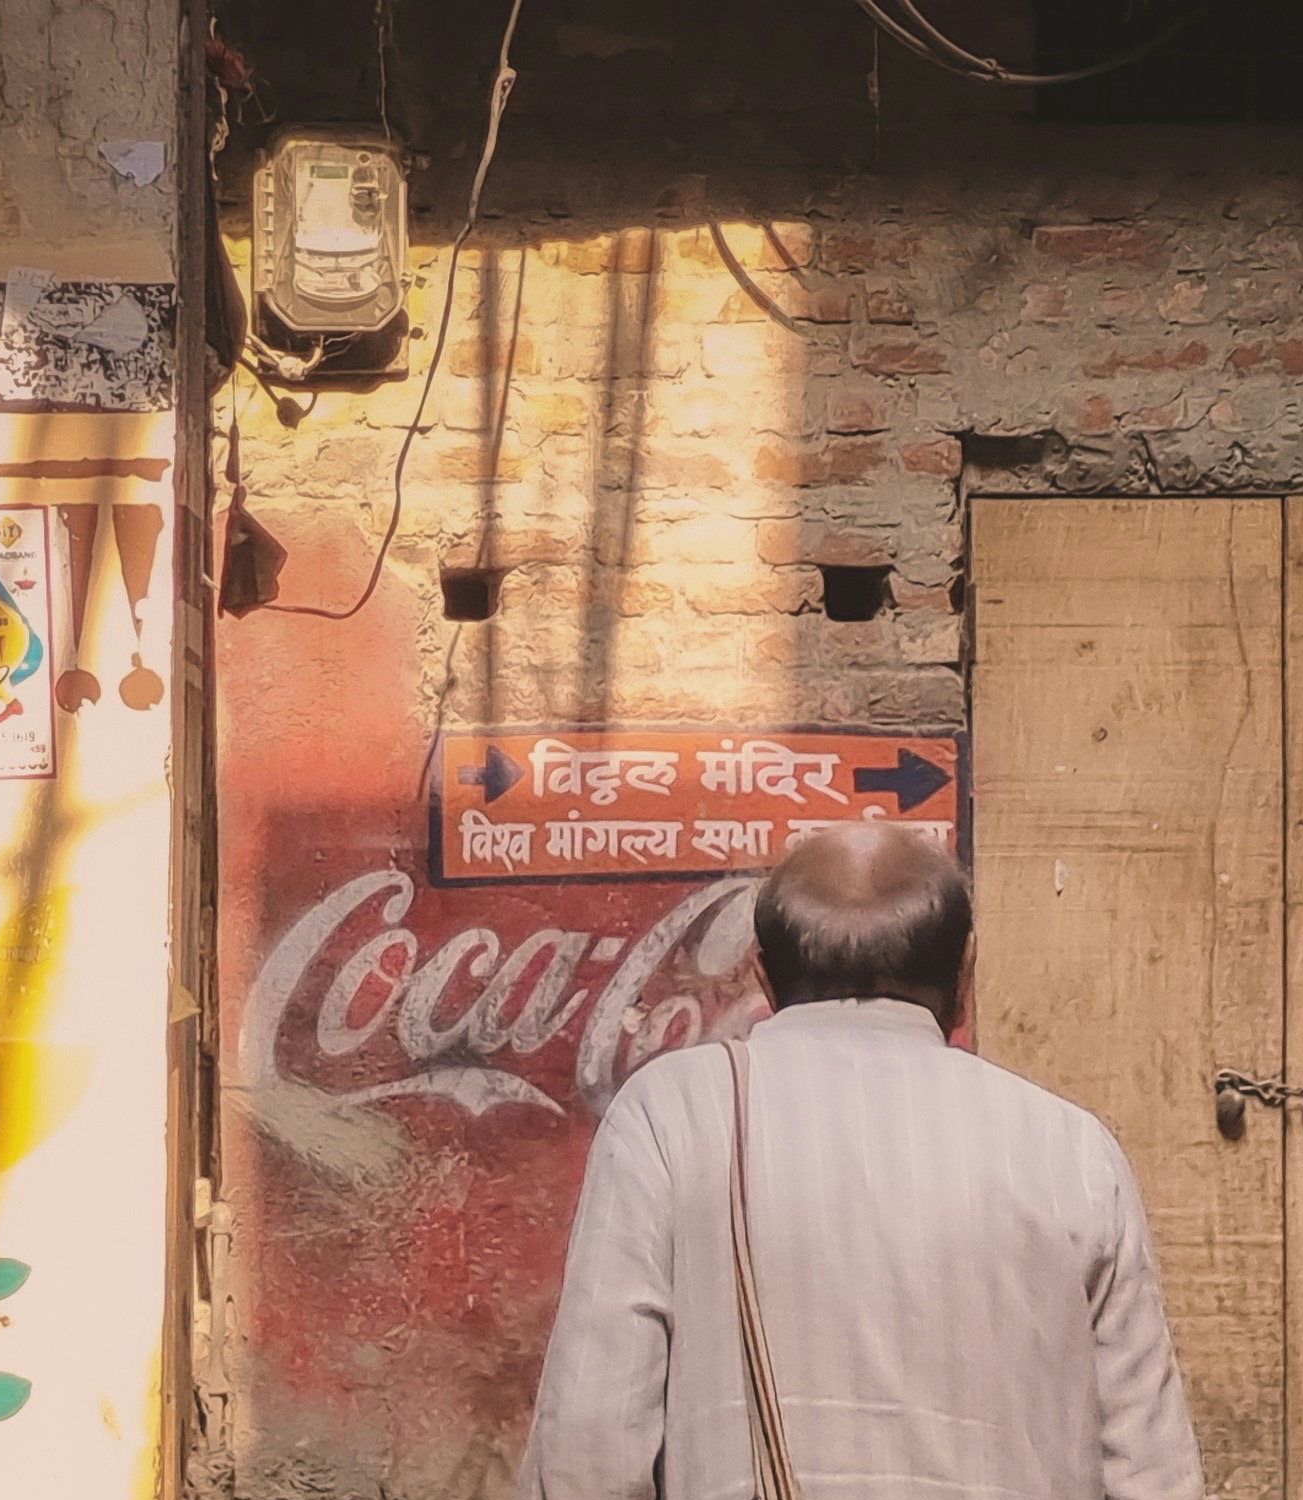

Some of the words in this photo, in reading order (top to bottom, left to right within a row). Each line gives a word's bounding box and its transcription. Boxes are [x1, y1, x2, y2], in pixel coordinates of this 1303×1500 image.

[695, 738, 850, 805] मंदिर
[458, 808, 537, 872] विश्व
[544, 809, 684, 866] मांगल्य
[690, 819, 774, 861] सभा
